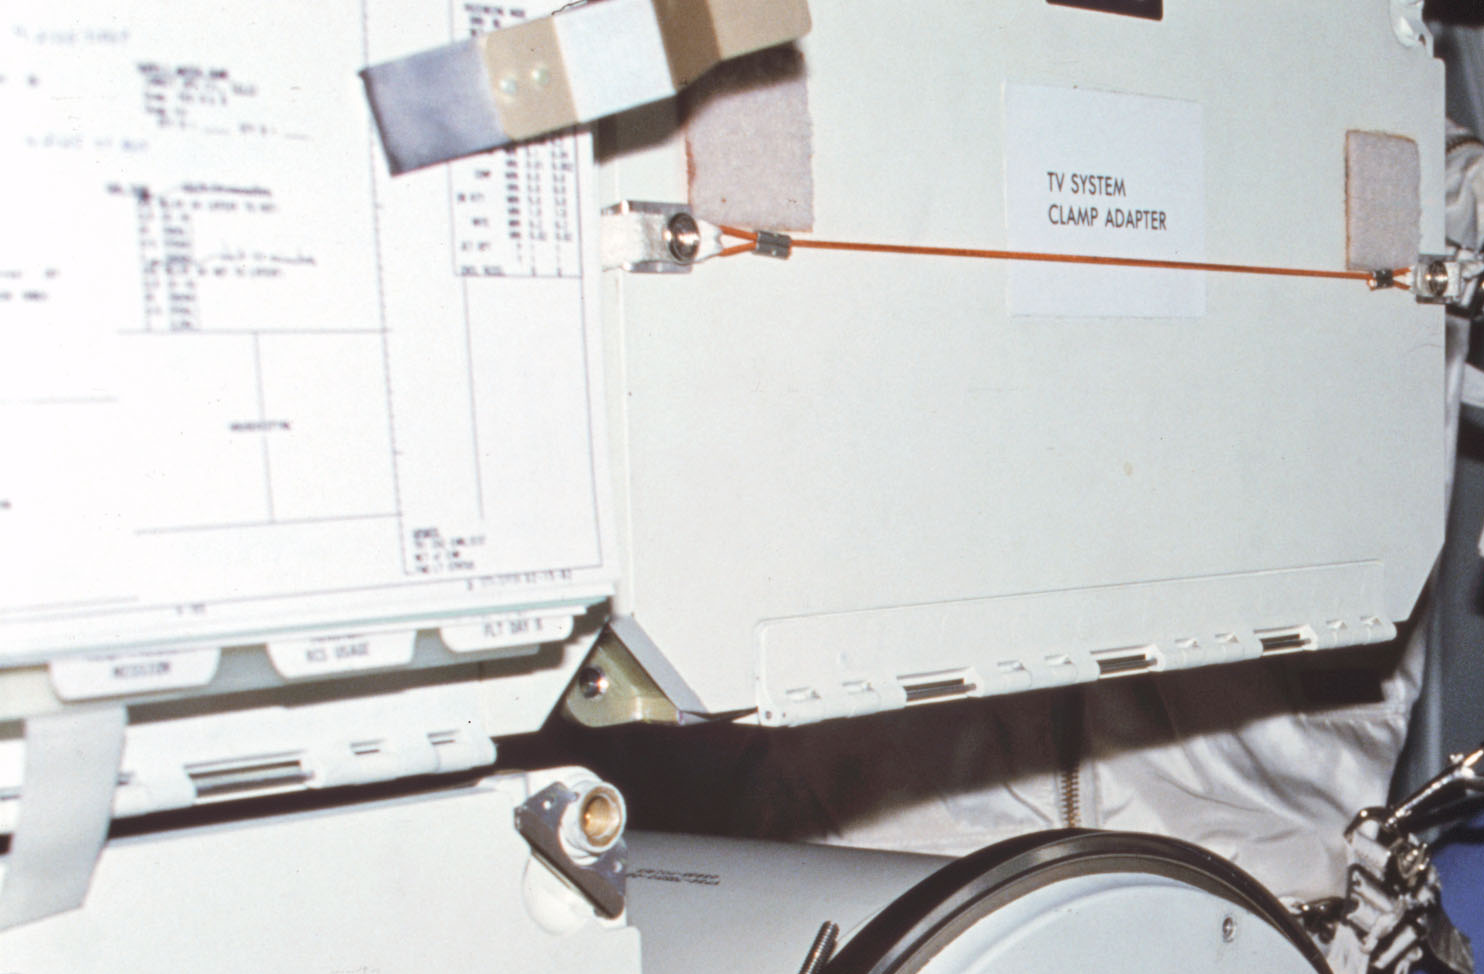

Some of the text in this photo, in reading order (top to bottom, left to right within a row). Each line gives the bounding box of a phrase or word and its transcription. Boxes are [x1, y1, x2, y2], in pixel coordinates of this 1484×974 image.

[1047, 171, 1126, 197] TV SYSTEM
[1048, 204, 1167, 231] CLAMP ADAPTER
